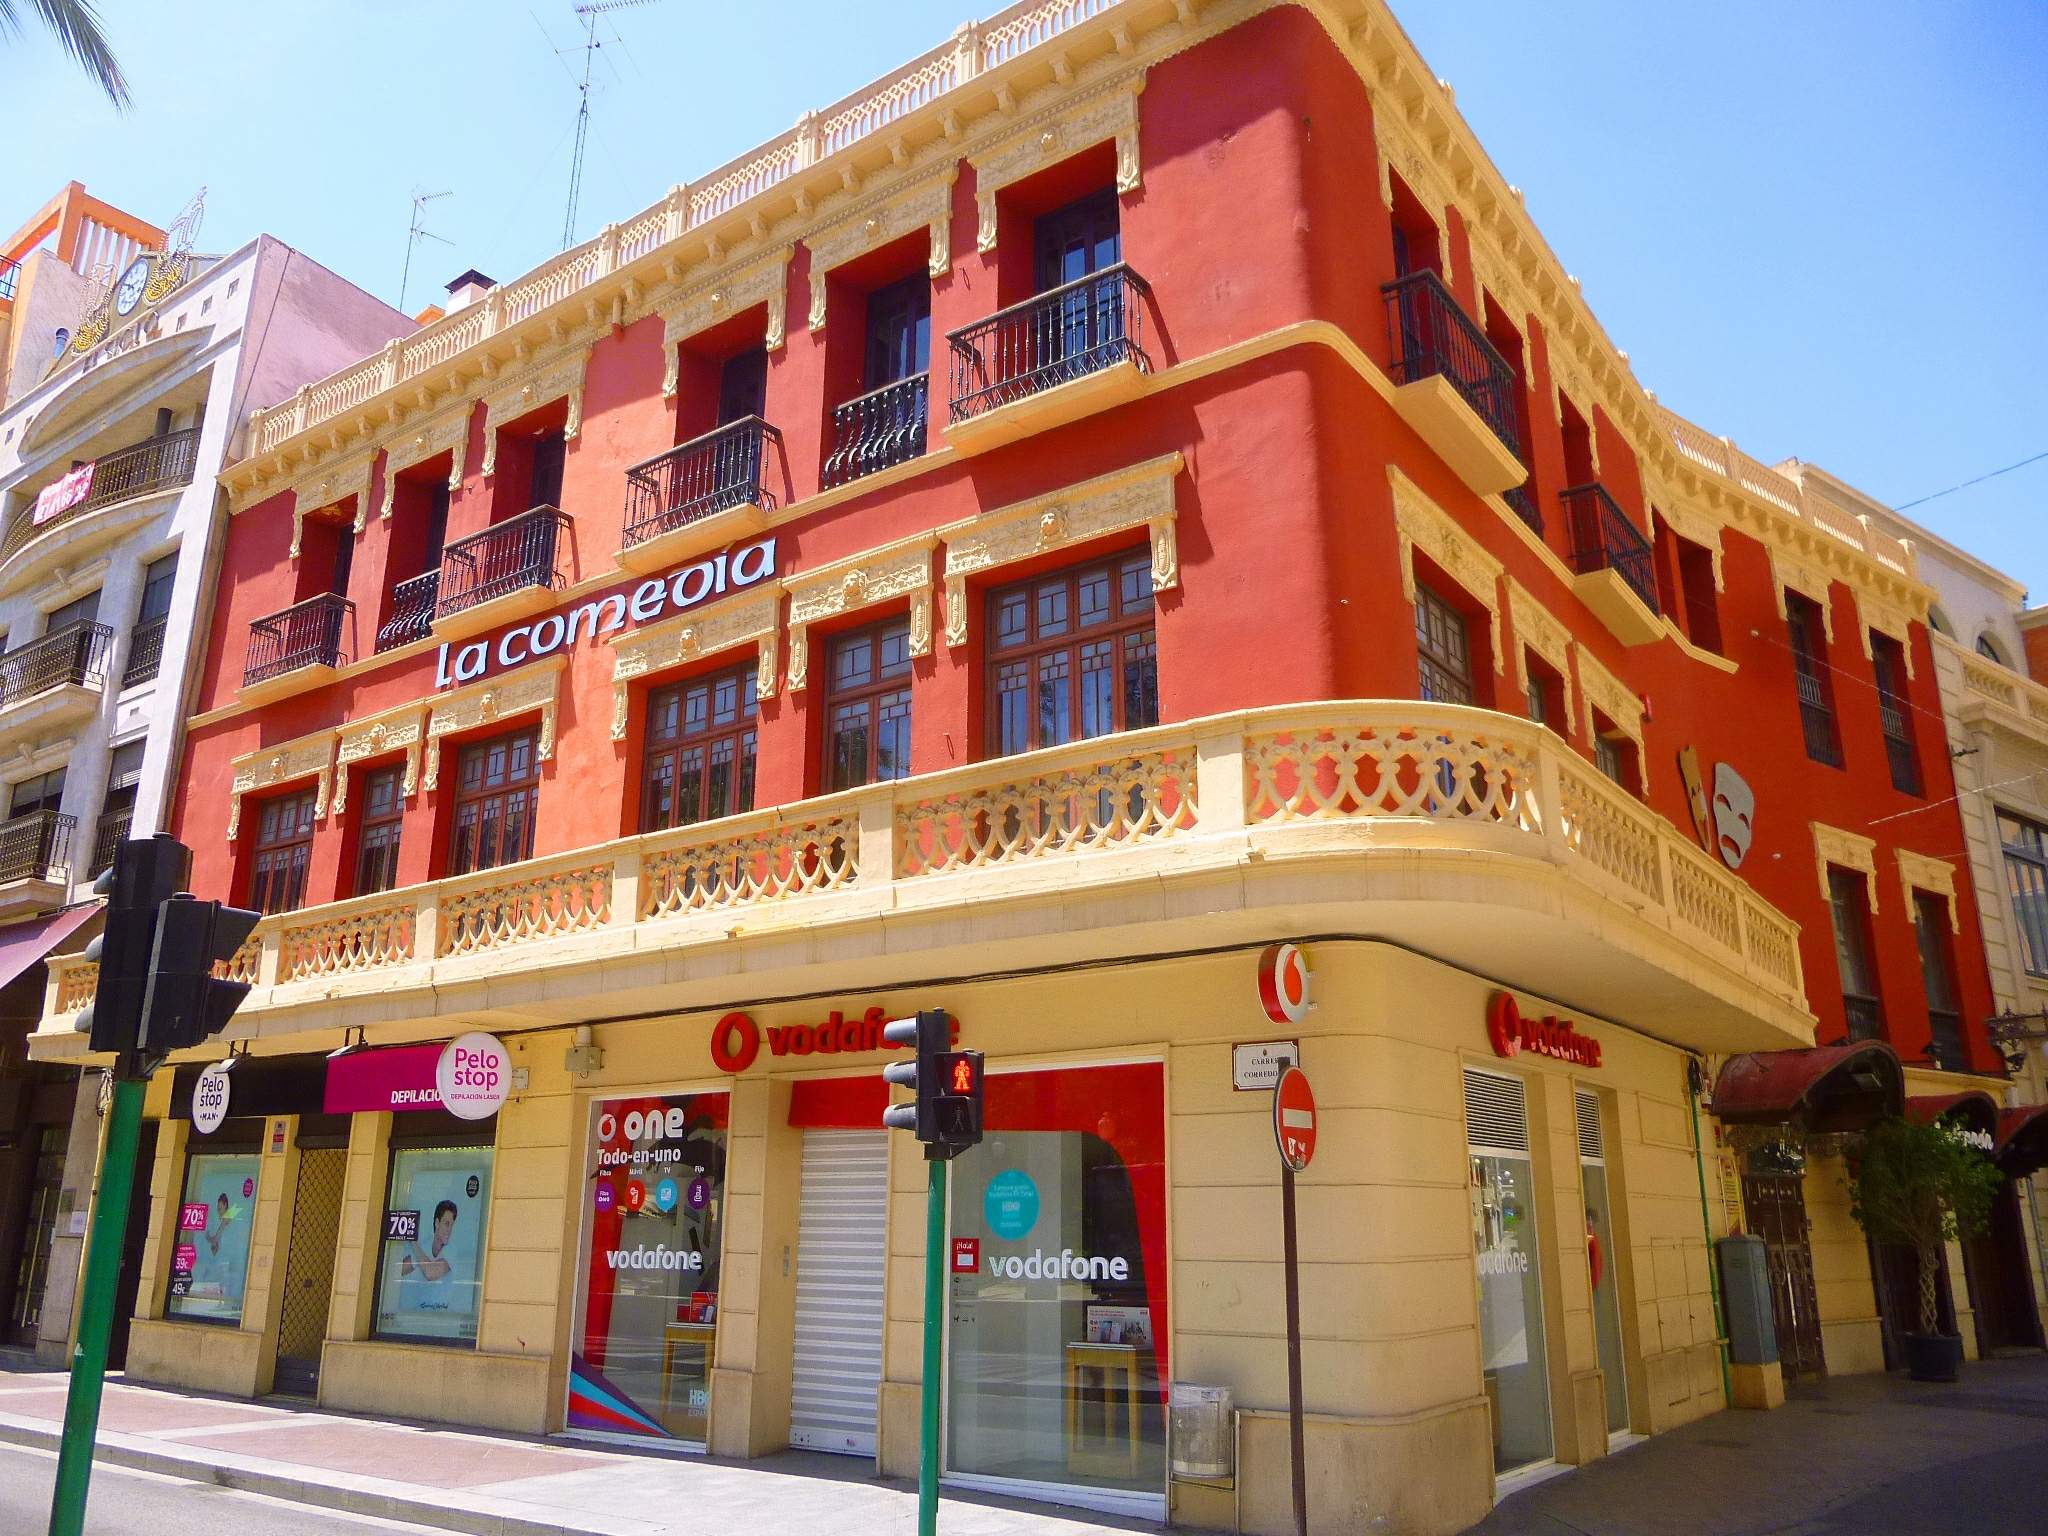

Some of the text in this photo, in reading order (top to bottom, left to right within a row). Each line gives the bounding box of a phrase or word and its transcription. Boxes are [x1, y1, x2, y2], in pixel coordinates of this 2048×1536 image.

[499, 537, 777, 666] comedia
[454, 1047, 499, 1070] Pelo
[1251, 1057, 1279, 1066] CARRE
[201, 1076, 224, 1093] Pelo
[453, 1067, 499, 1091] stop
[1243, 1070, 1278, 1079] CORREDO
[199, 1092, 222, 1110] stop
[390, 1088, 441, 1104] DEPILACIO
[624, 1107, 685, 1141] one
[597, 1148, 682, 1165] Todo-en-uno
[389, 1216, 416, 1236] 70%
[606, 1243, 703, 1270] vodafone
[988, 1248, 1129, 1281] vodafone
[1478, 1246, 1529, 1275] odafone
